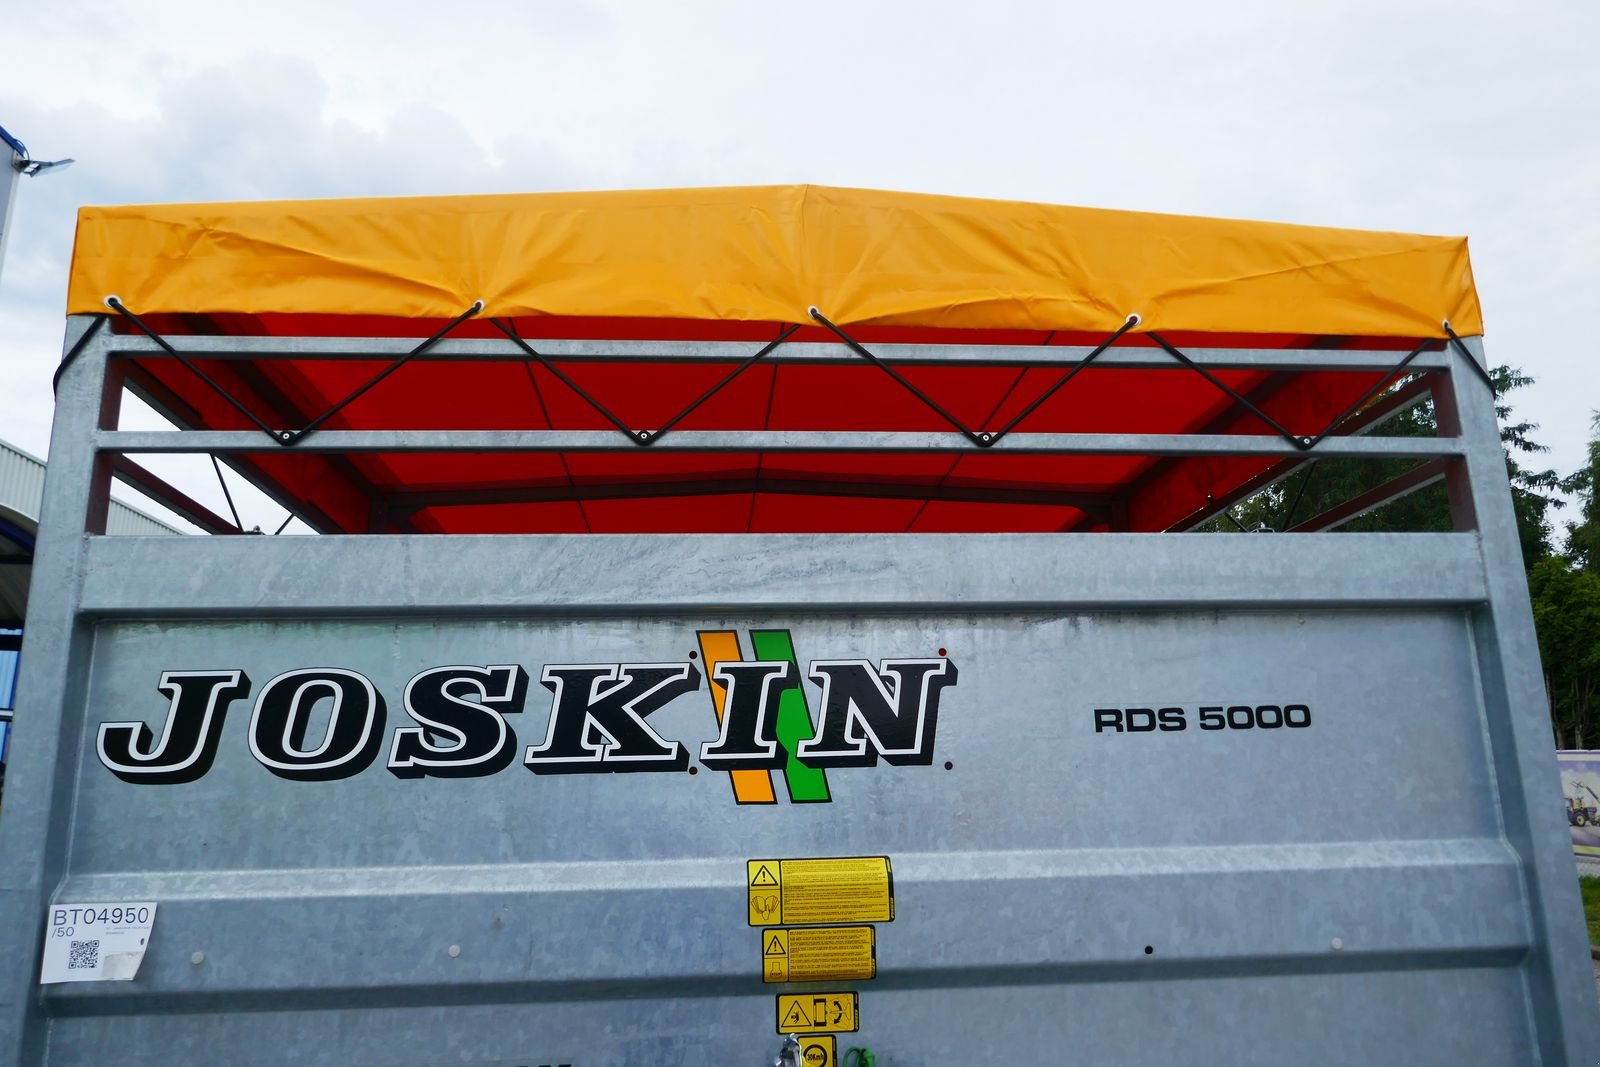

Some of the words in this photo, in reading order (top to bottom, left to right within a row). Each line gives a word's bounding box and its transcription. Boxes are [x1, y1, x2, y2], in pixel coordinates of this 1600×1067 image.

[97, 658, 957, 785] JOSKIN
[1094, 707, 1187, 733] RDS
[1199, 704, 1311, 731] 5000
[53, 907, 149, 926] BT04950
[52, 926, 75, 938] /50
